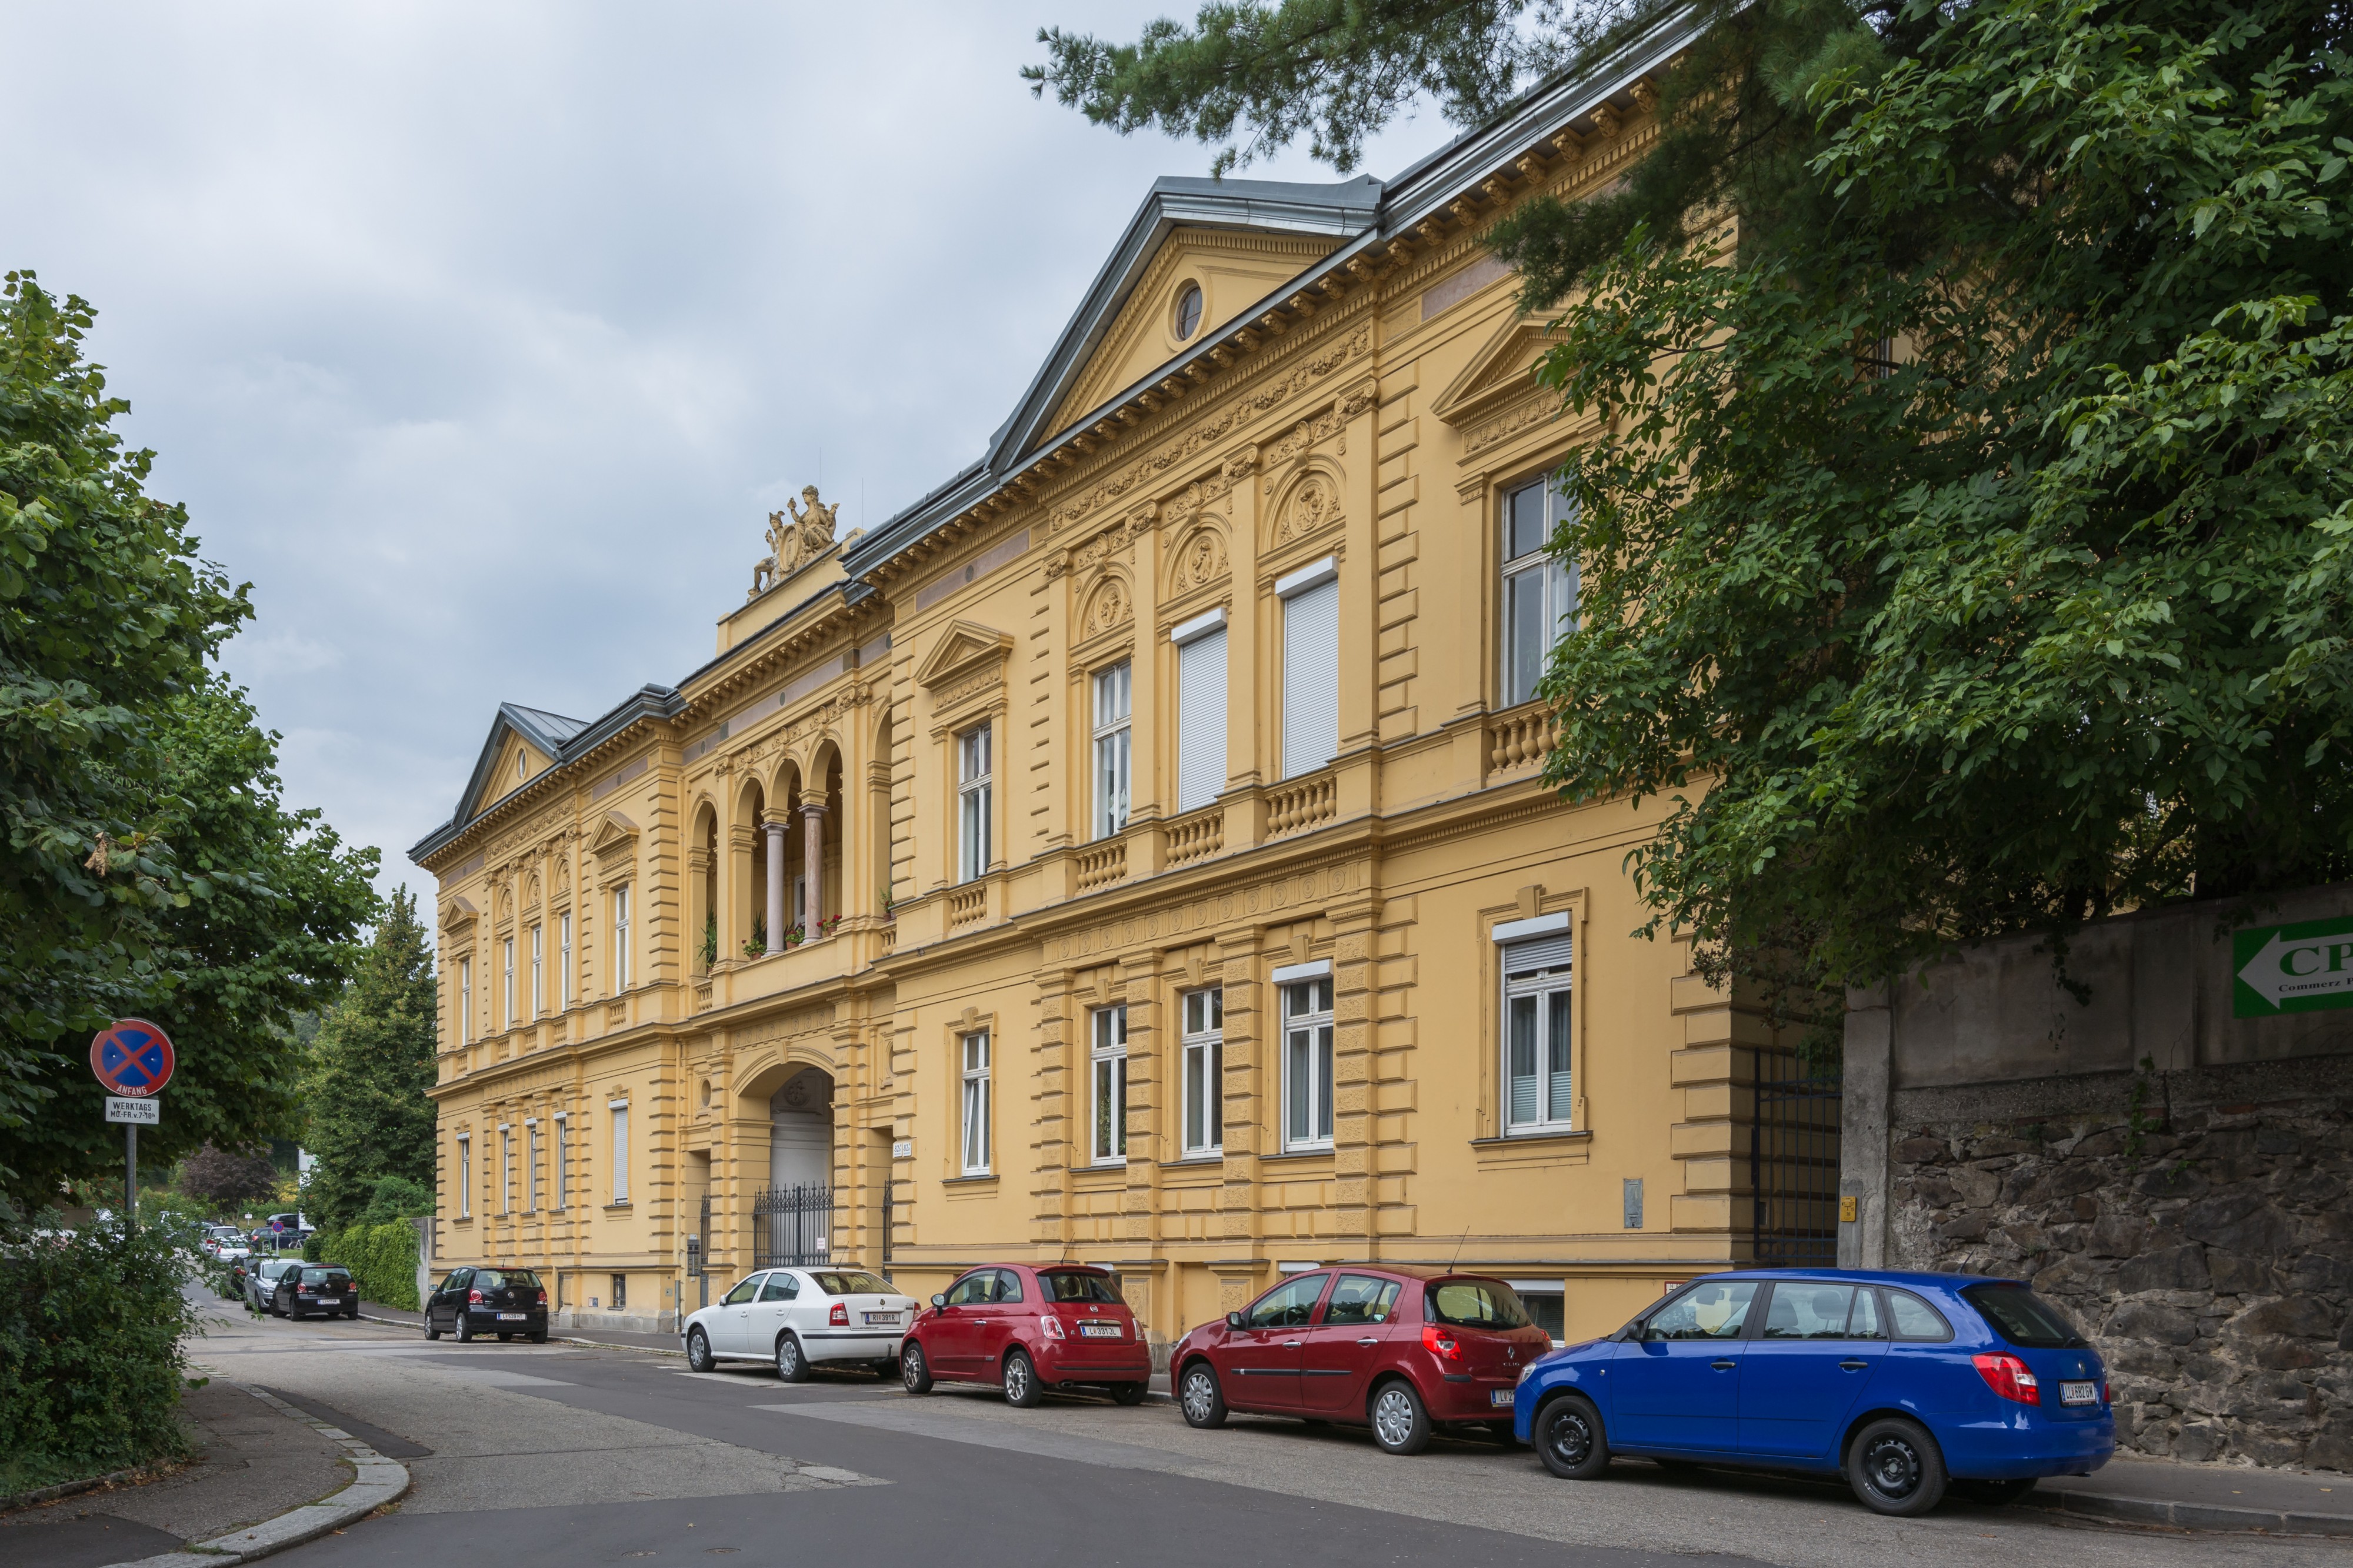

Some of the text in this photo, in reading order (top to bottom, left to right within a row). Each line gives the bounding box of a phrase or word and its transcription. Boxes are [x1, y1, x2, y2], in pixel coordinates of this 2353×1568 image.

[2278, 980, 2341, 992] Commerz
[116, 1085, 147, 1096] ANFANG
[113, 1101, 152, 1111] WERKTAGS
